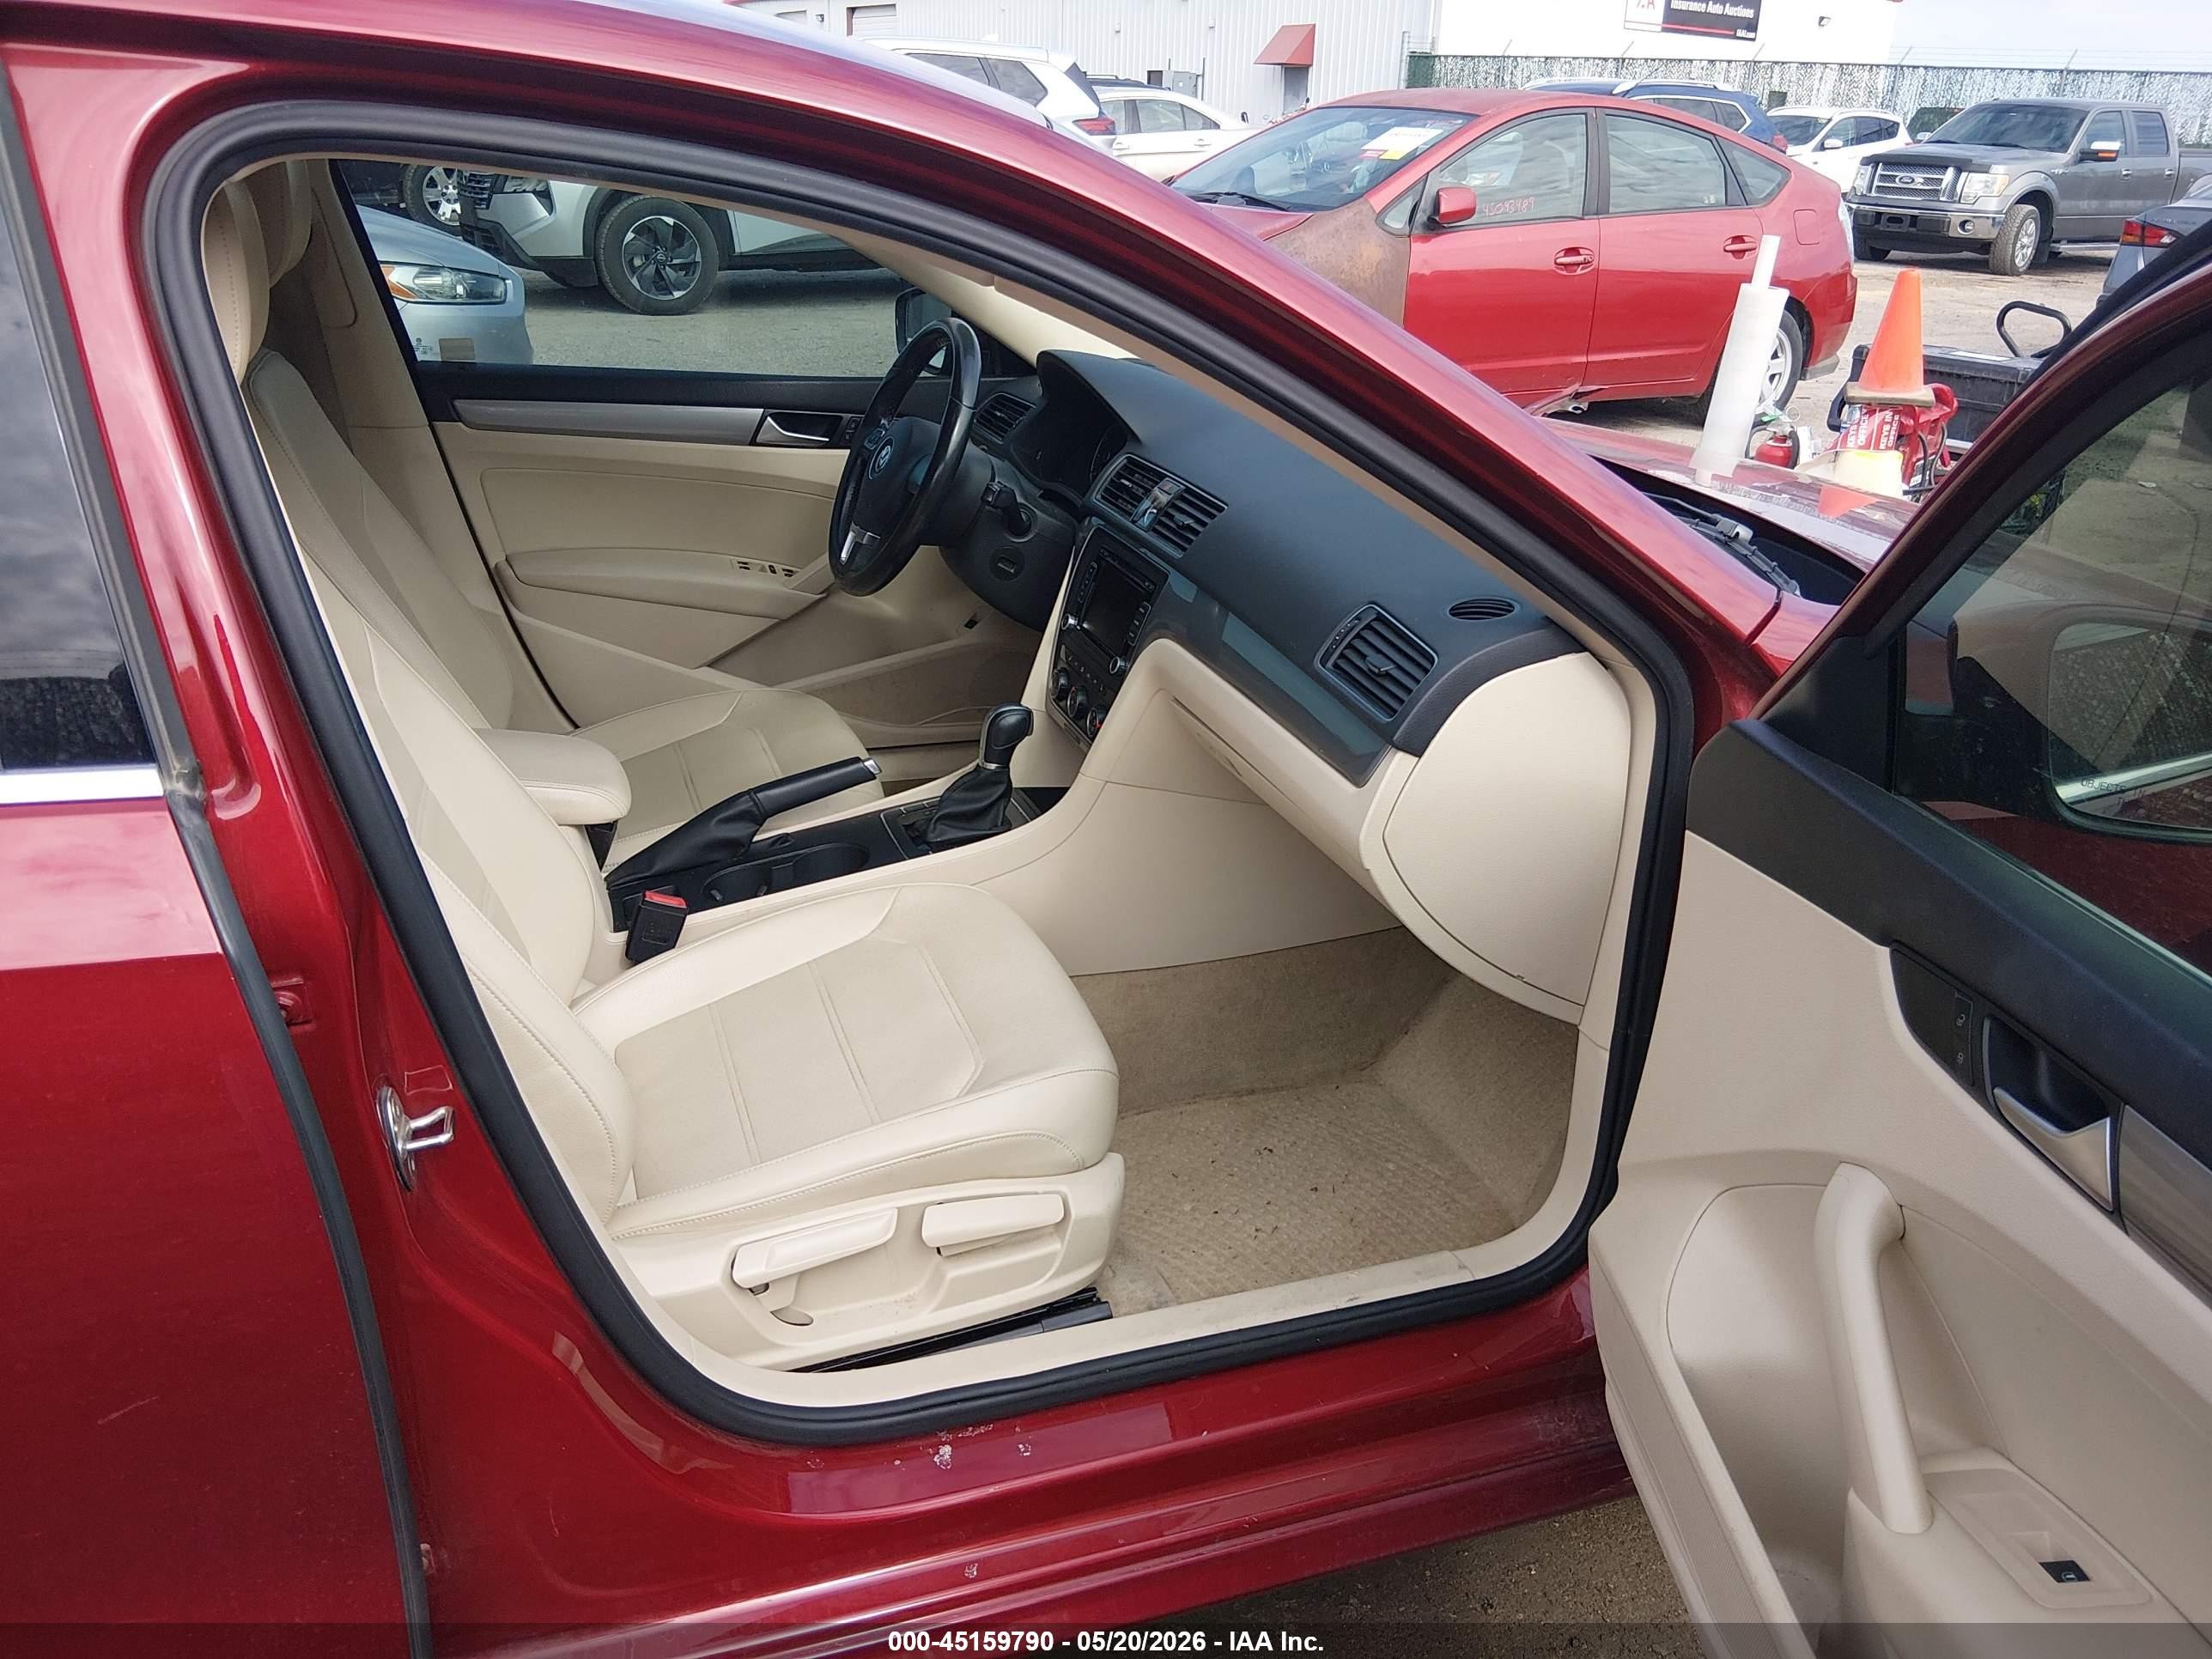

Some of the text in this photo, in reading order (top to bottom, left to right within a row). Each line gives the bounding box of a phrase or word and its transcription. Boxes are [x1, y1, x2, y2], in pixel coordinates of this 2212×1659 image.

[1670, 0, 1754, 18] Insurance Auto Auctions
[1884, 411, 1893, 422] IN
[1857, 414, 1869, 446] OFFICE
